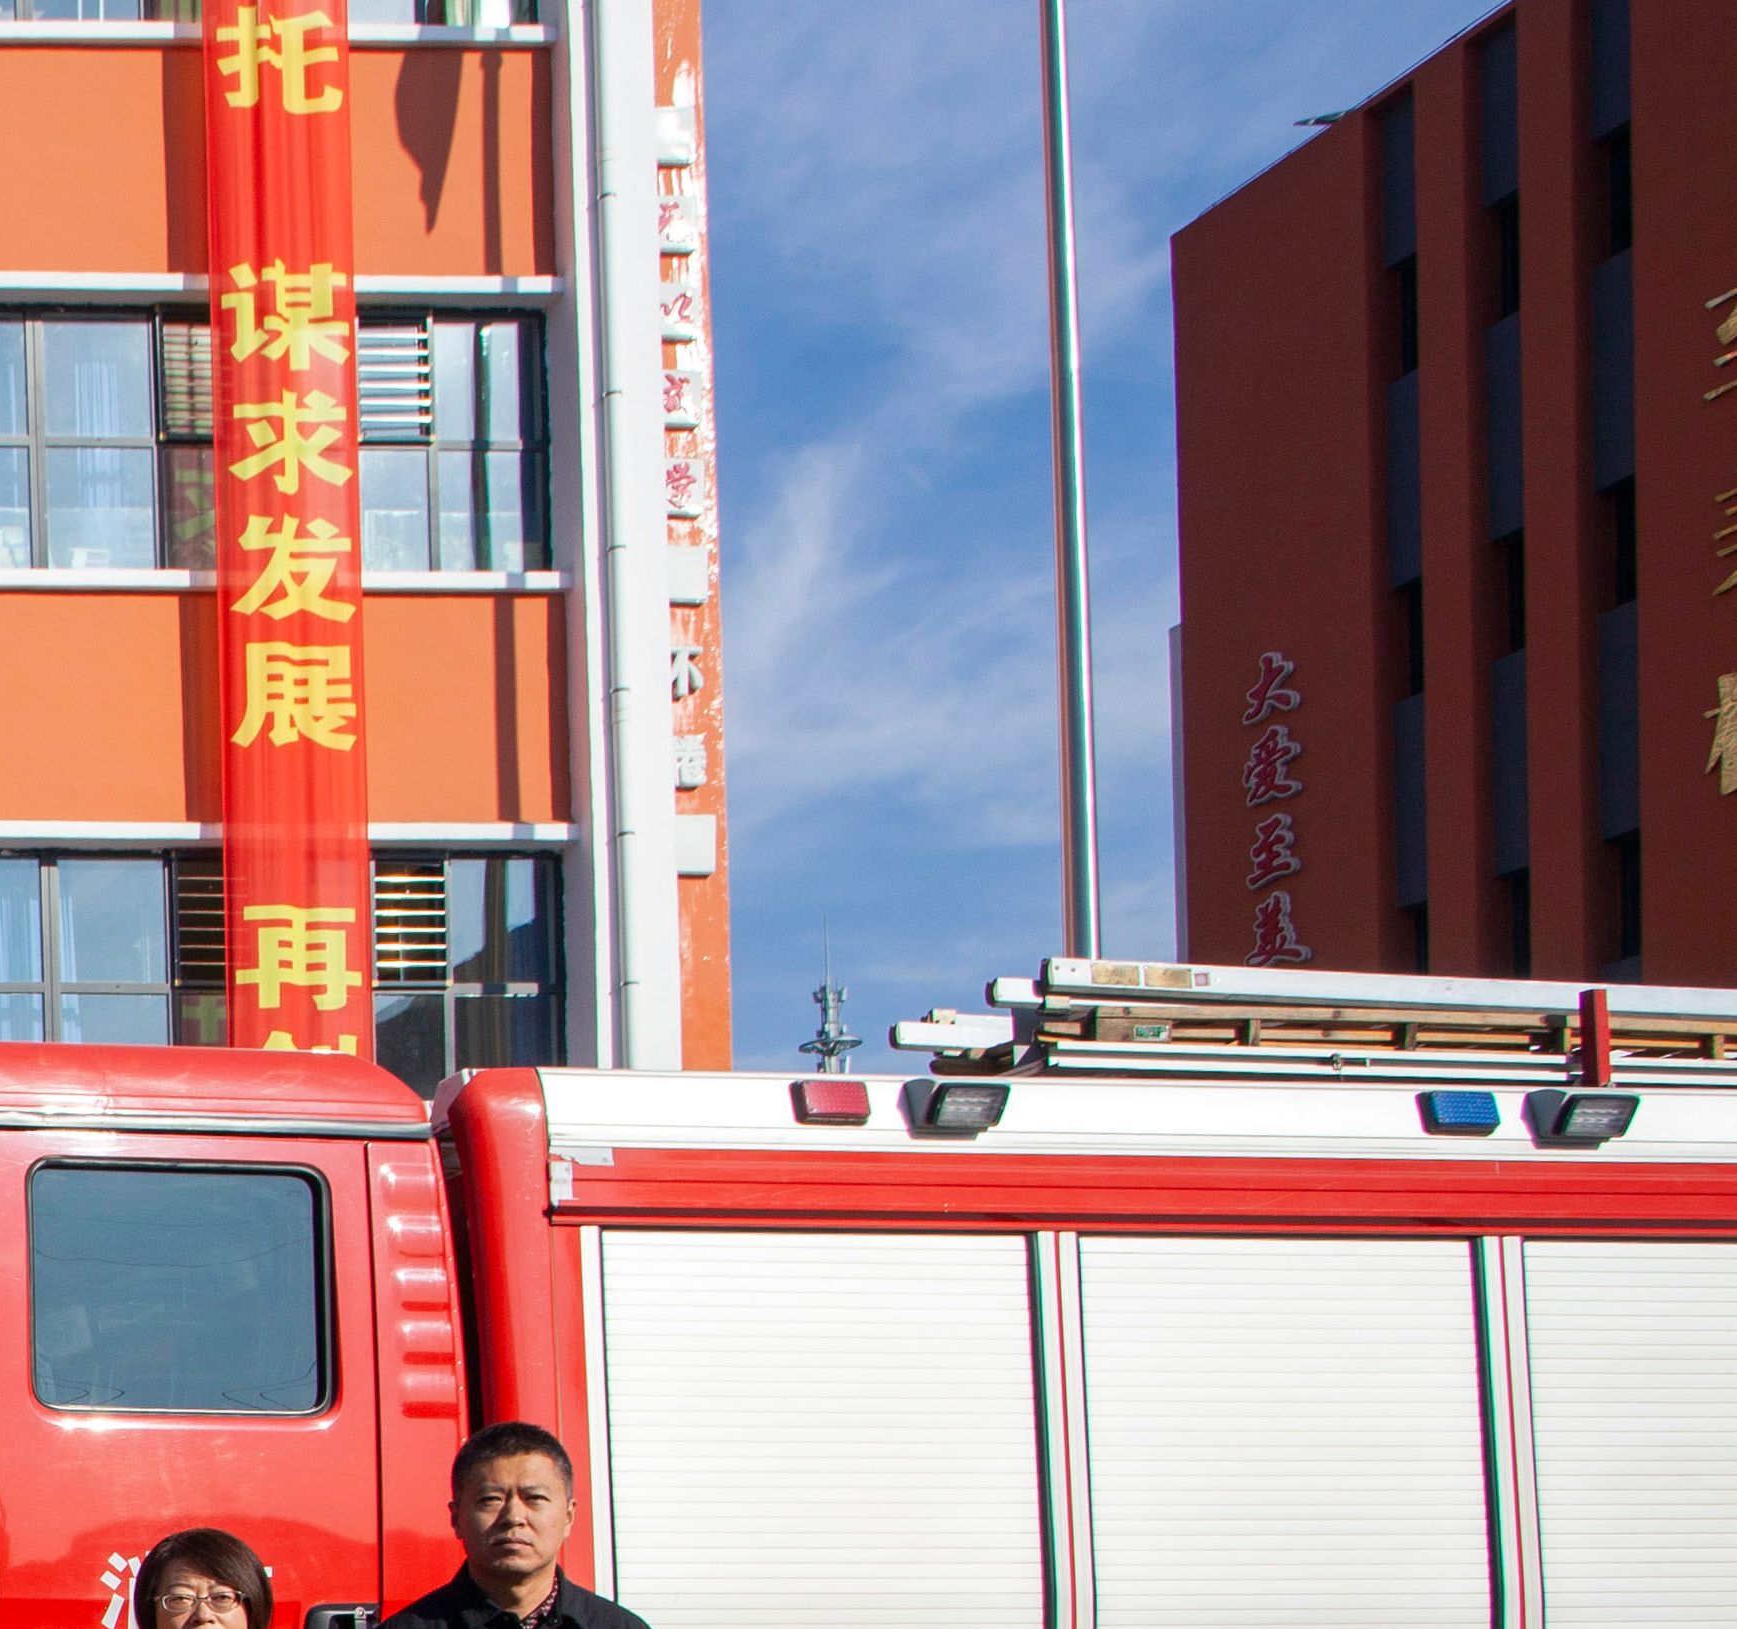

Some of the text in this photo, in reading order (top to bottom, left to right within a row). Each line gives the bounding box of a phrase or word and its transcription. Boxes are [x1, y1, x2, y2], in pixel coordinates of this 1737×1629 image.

[216, 5, 365, 1050] 托 谋求发展 再
